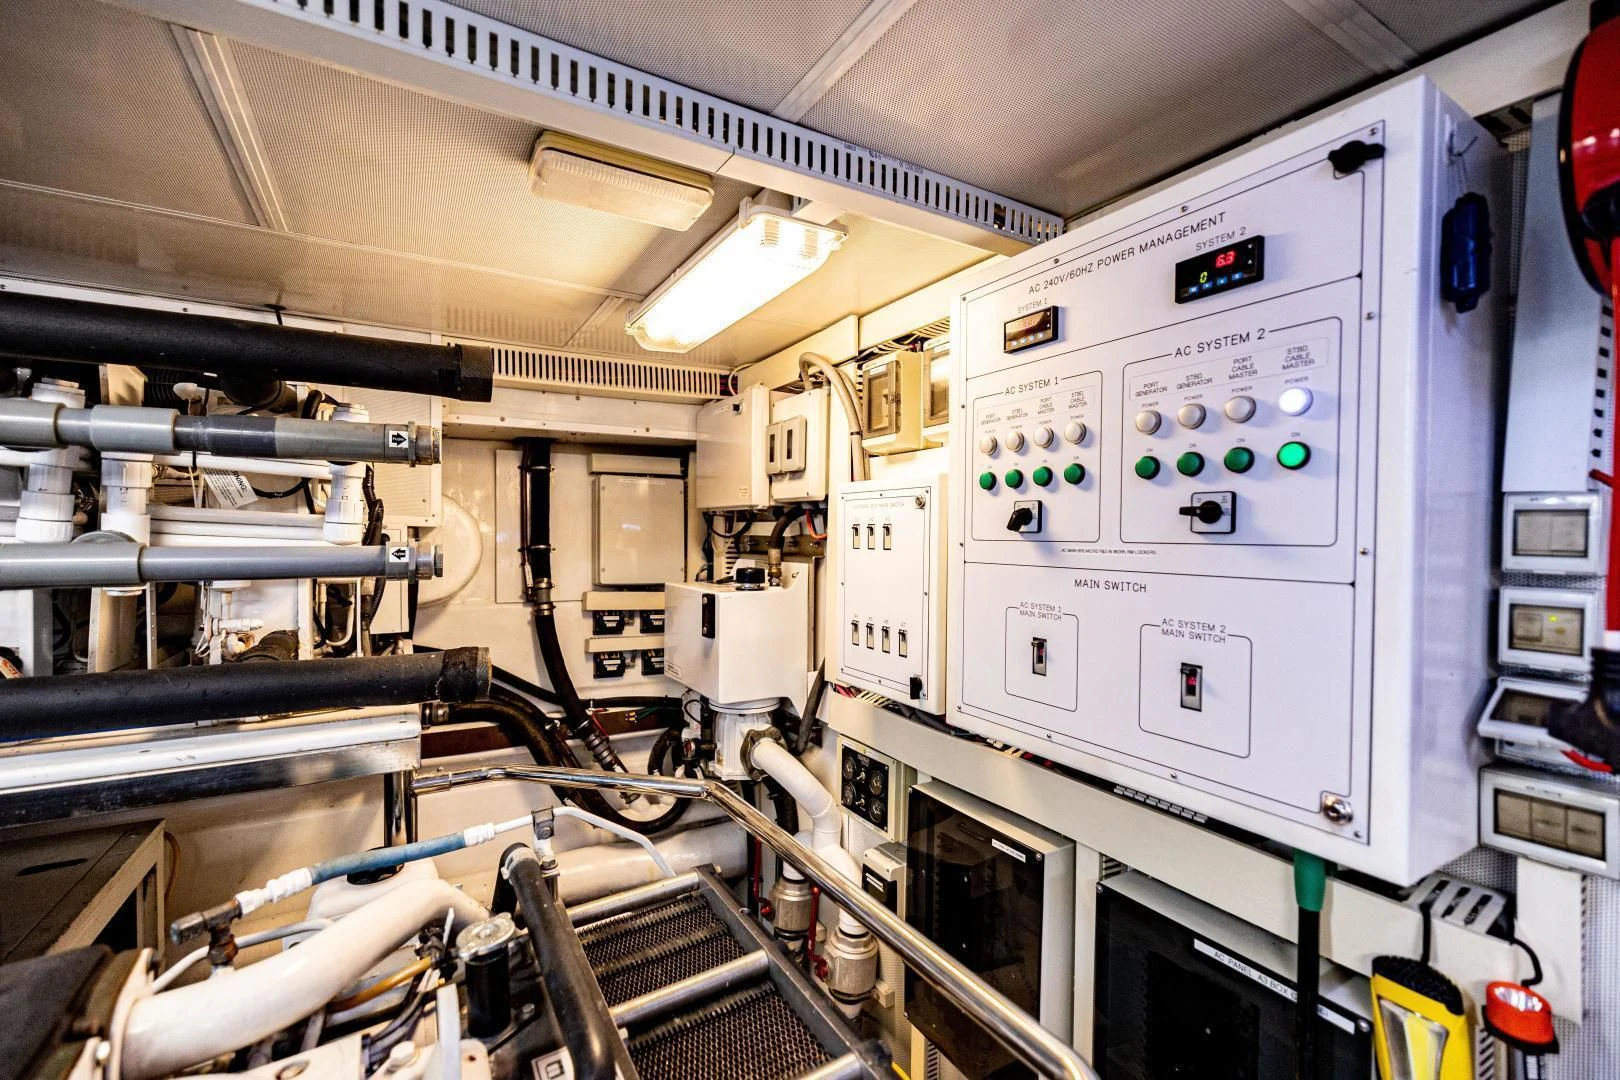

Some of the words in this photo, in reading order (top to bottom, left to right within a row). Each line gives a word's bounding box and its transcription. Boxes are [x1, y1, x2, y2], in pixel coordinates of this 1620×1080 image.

[1196, 230, 1235, 251] SYSTEM
[1239, 226, 1247, 236] 2
[1028, 281, 1041, 295] AC
[1043, 262, 1094, 290] 240V/60HZ
[1097, 247, 1135, 269] POWER
[1139, 211, 1227, 253] MANAGEMENT
[1017, 299, 1042, 314] SYSTEM
[1174, 345, 1192, 358] AC
[1197, 331, 1250, 354] SYSTEM
[1257, 328, 1266, 340] 2
[1233, 356, 1252, 365] PORT
[1282, 359, 1315, 370] MASTER
[1231, 362, 1255, 373] CABLE
[1185, 373, 1203, 381] STBD
[1228, 369, 1258, 380] MASTER
[1004, 387, 1016, 396] AC
[1018, 379, 1051, 393] SYSTEM
[1054, 376, 1059, 385] 1
[1143, 381, 1159, 389] PORT
[1176, 378, 1213, 390] GENERATOR
[1231, 385, 1253, 393] POWER
[1135, 386, 1168, 397] GENERATOR
[1074, 579, 1100, 589] MAIN
[1104, 580, 1147, 593] SWITCH
[1030, 602, 1055, 612] SYSTEM
[1020, 610, 1035, 618] MAIN
[1037, 612, 1062, 621] SWITCH
[1162, 618, 1174, 627] AC
[1178, 620, 1216, 632] SYSTEM
[1220, 625, 1227, 634] 2
[1161, 629, 1185, 638] MAIN
[1189, 631, 1226, 644] SWITCH
[1214, 951, 1225, 962] AC
[1228, 957, 1254, 978] PANEL
[1257, 973, 1269, 986] A3
[1269, 979, 1288, 995] BOX
